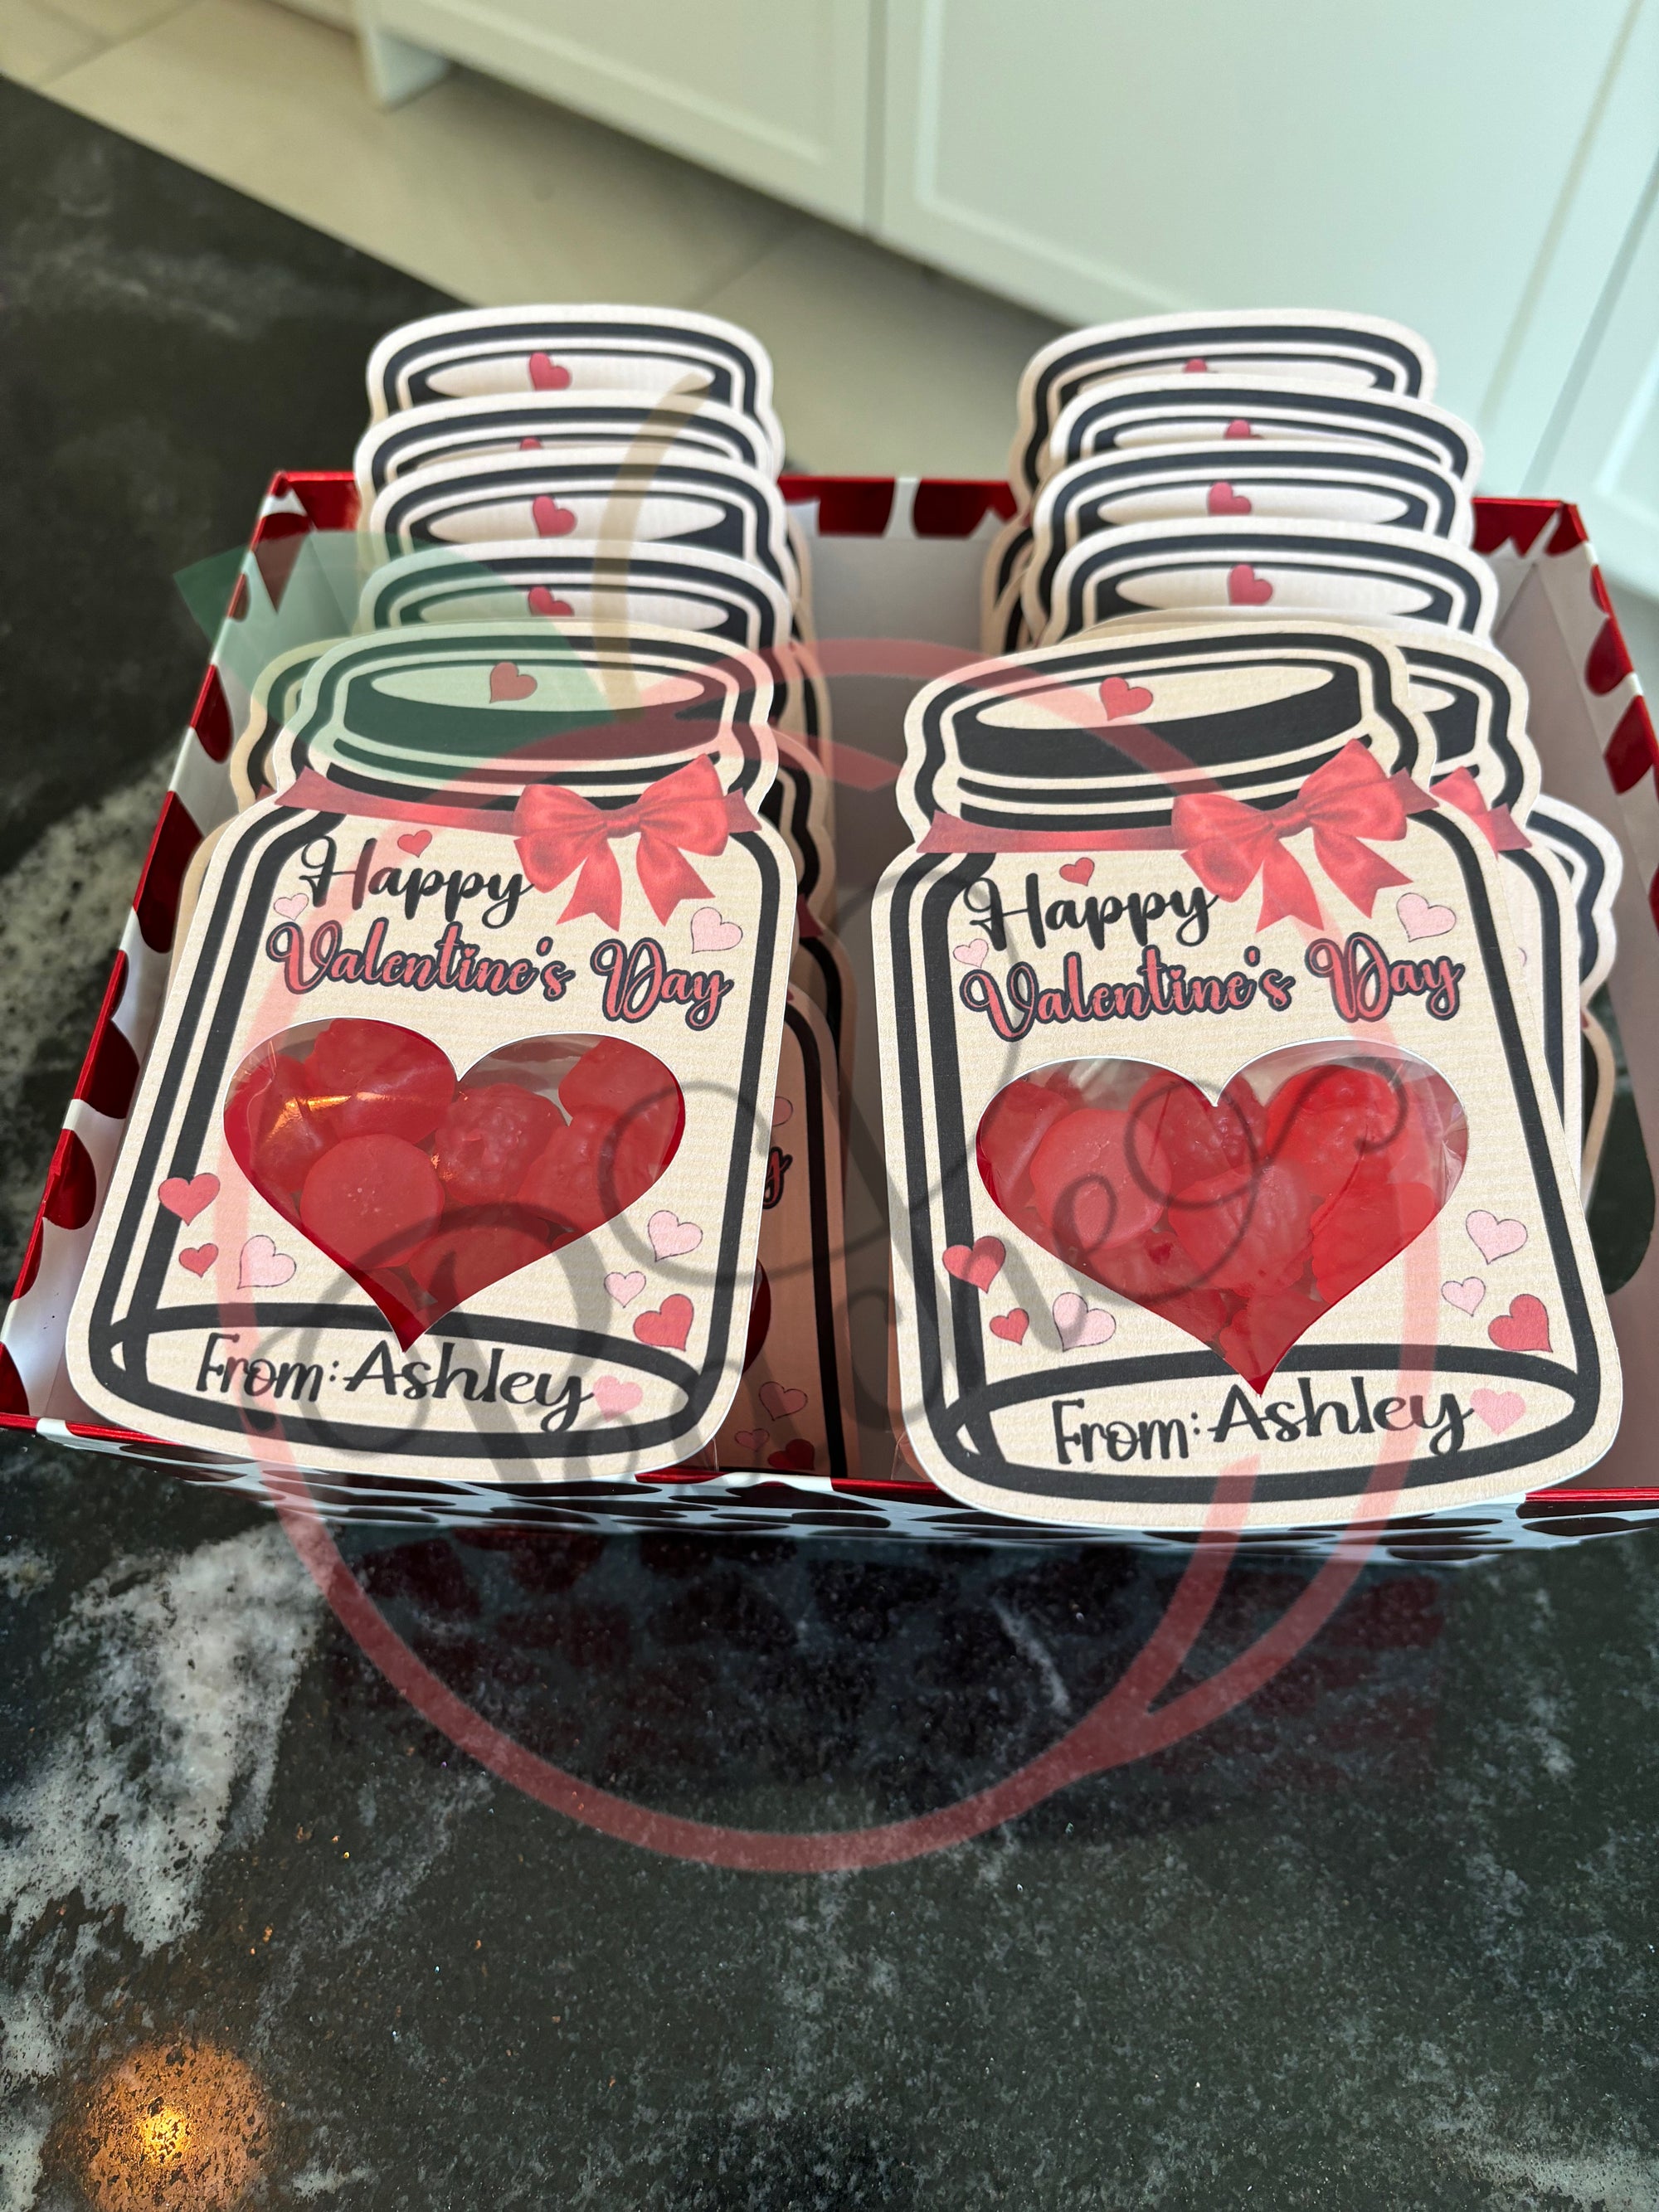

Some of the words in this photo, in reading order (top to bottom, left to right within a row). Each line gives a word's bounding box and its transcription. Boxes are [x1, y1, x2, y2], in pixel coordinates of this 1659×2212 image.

[299, 834, 536, 930] Happy
[962, 872, 1219, 951] Happy
[265, 916, 577, 1001] Valentine's
[590, 936, 735, 1032] Day
[959, 942, 1296, 1042] Valentine's
[1305, 931, 1466, 1021] Day
[343, 1340, 595, 1433] Ashley
[1208, 1376, 1474, 1455] Ashley
